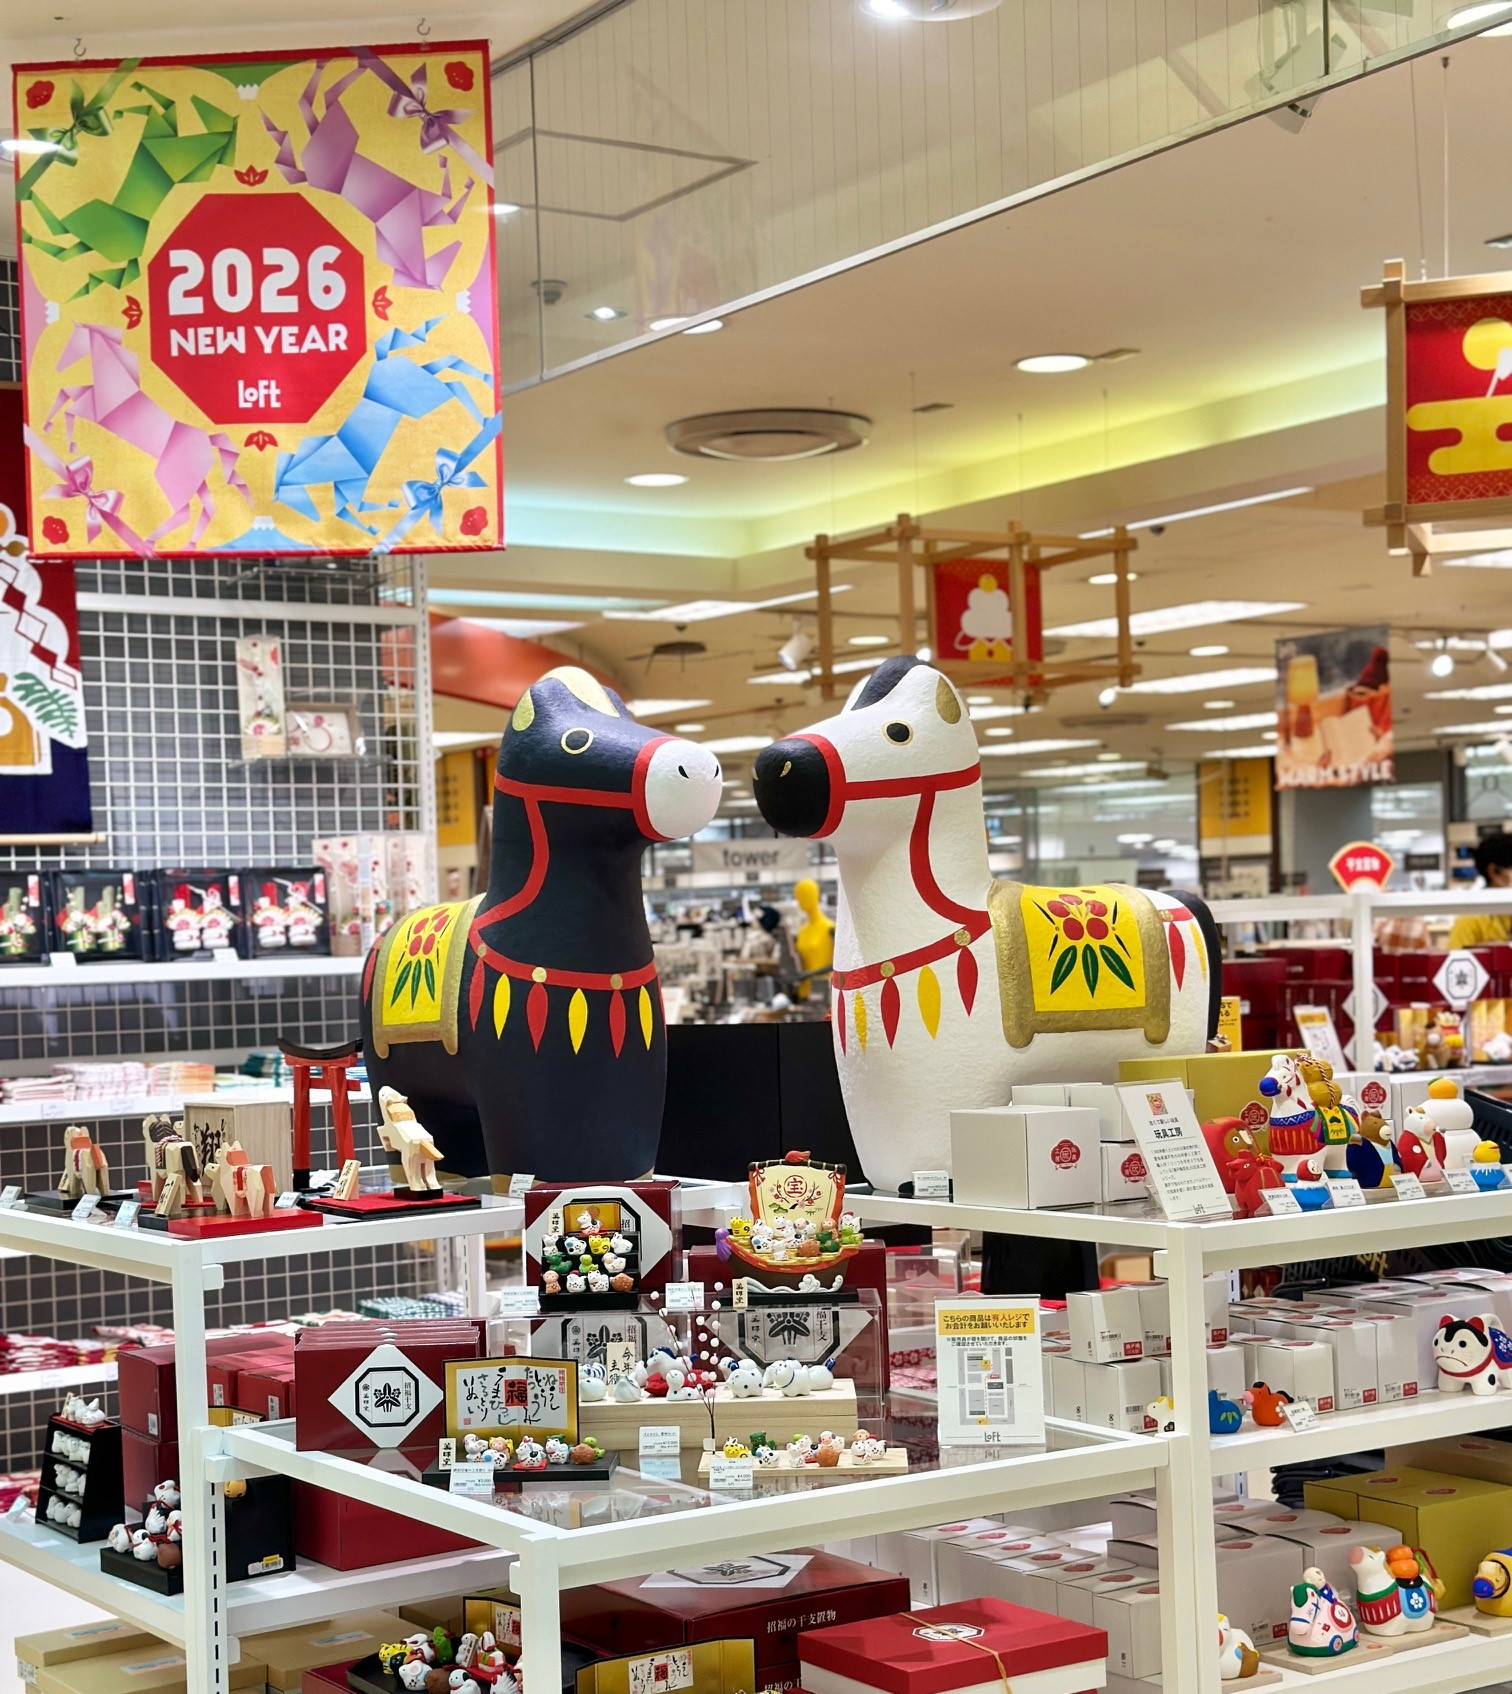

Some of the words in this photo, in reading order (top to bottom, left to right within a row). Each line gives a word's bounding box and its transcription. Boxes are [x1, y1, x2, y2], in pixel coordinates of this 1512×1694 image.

[168, 245, 346, 315] 2026
[170, 326, 246, 357] NEW
[254, 323, 348, 354] YEAR
[723, 848, 780, 867] tower
[1153, 1127, 1183, 1139] 玩具工房
[787, 1178, 803, 1196] 宝
[943, 1313, 1030, 1323] こちらの商品は有人レジで
[945, 1321, 1028, 1330] お会計をお願いいたします
[621, 1346, 634, 1375] 今年
[505, 1380, 528, 1404] 福
[766, 1609, 836, 1634] 招福の干支置物
